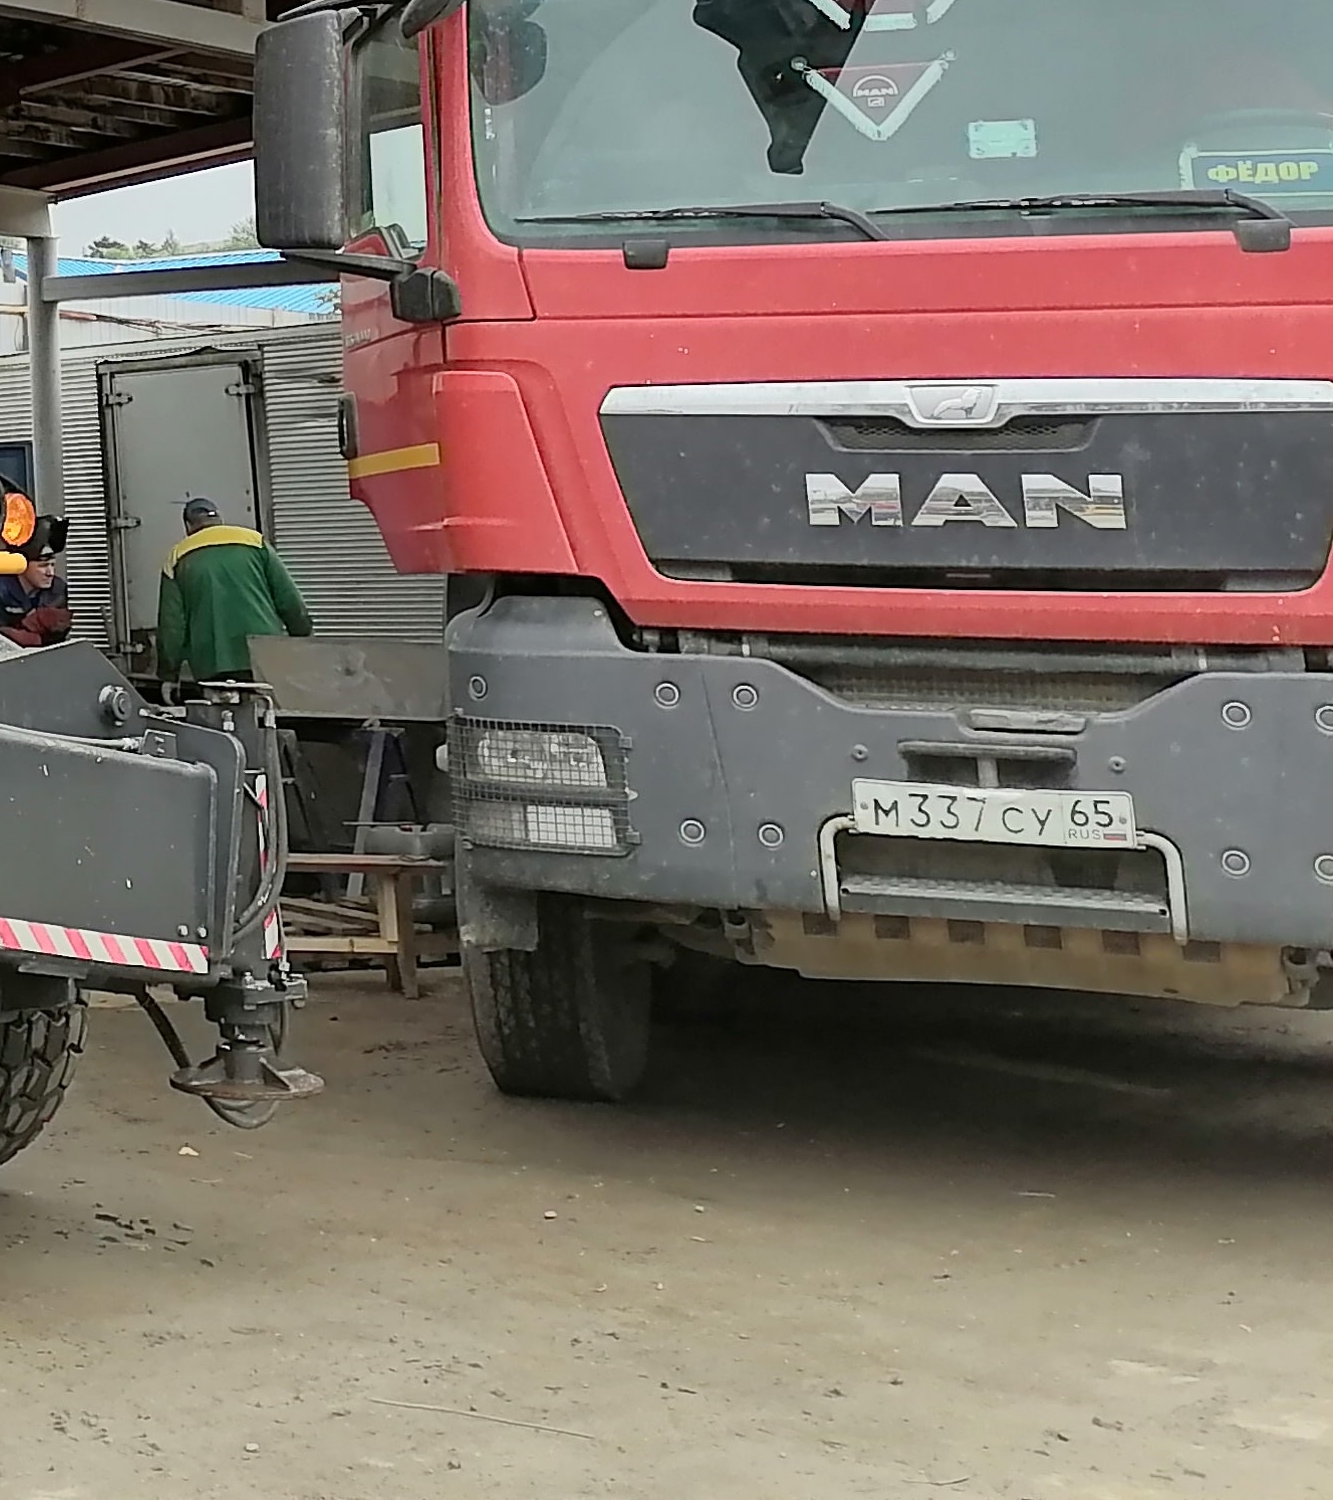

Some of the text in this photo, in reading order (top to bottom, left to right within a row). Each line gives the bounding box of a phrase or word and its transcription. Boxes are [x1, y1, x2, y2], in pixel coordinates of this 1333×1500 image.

[1207, 160, 1318, 184] ФЁДОР
[805, 472, 1127, 529] MAN
[1070, 800, 1114, 828] 65
[1068, 828, 1101, 841] RUS
